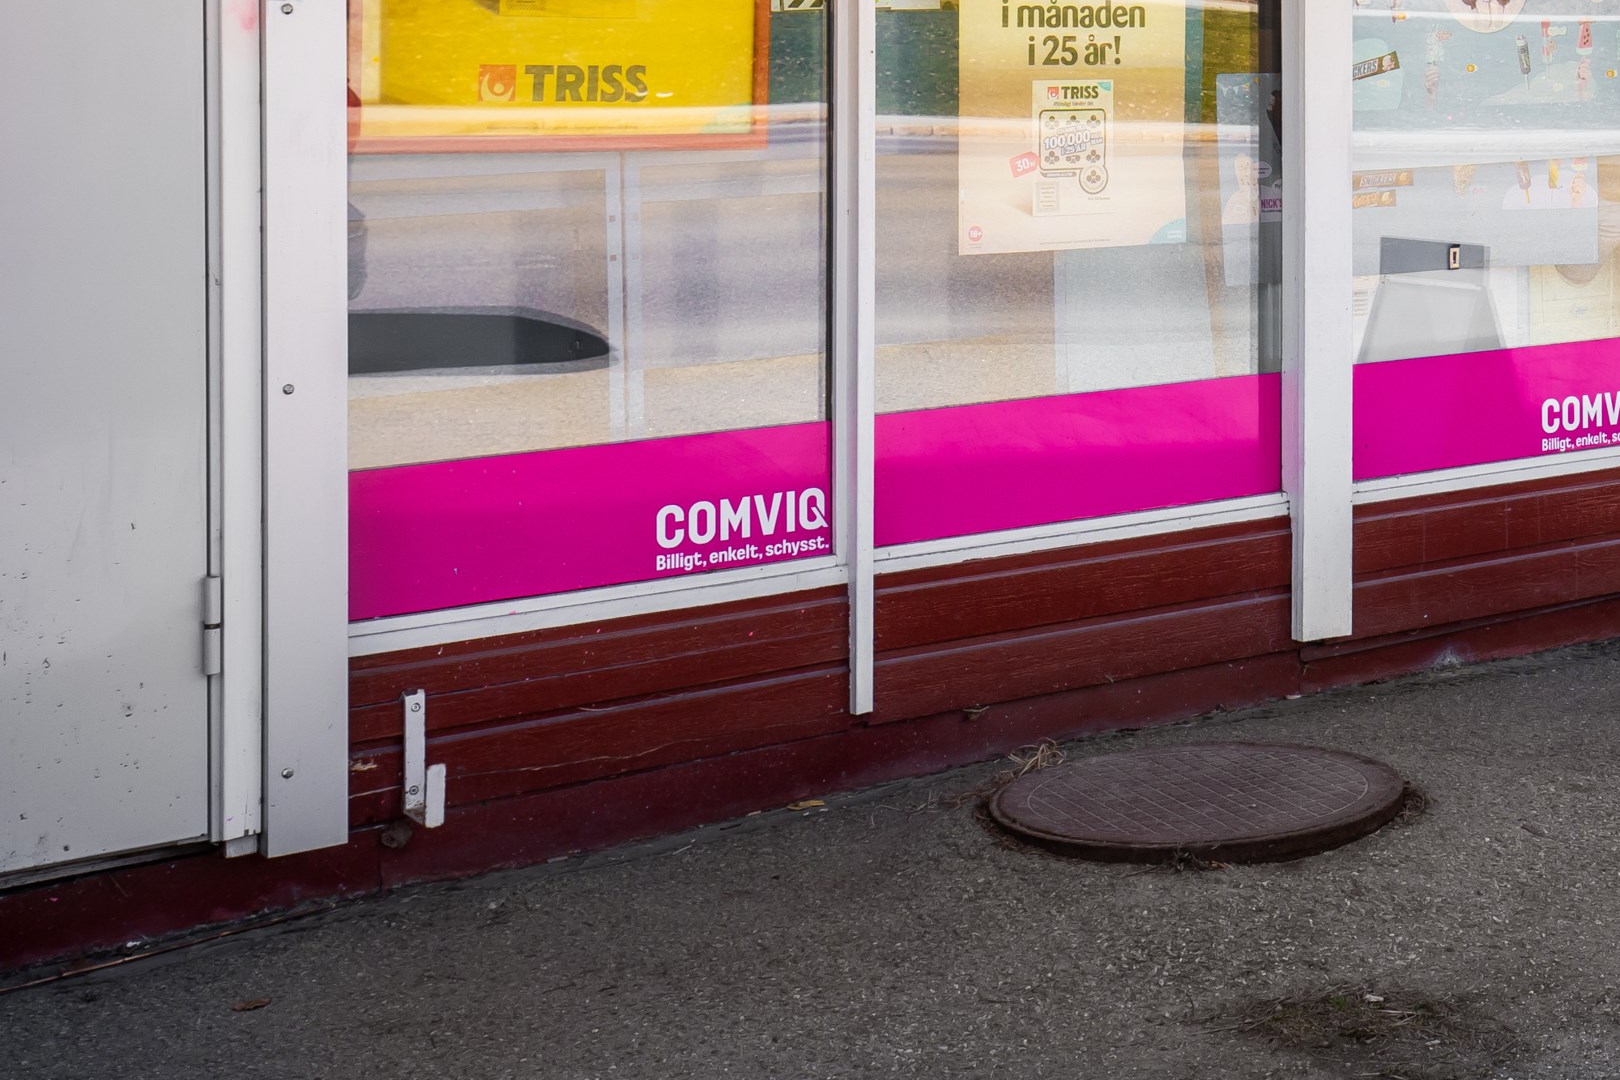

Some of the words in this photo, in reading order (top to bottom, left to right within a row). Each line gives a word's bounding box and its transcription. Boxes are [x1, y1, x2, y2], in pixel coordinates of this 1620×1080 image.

[1028, 35, 1035, 66] i
[1042, 35, 1078, 66] 25
[1084, 34, 1121, 66] år!
[524, 65, 648, 104] TRISS
[1061, 85, 1099, 100] TRISS
[970, 229, 982, 238] 18+
[1542, 437, 1575, 452] Billigt,
[1576, 432, 1611, 447] enkelt,
[656, 487, 828, 549] COMVIQ
[656, 550, 707, 572] Billigt,
[709, 543, 763, 565] enkelt,
[765, 535, 830, 558] schysst.
